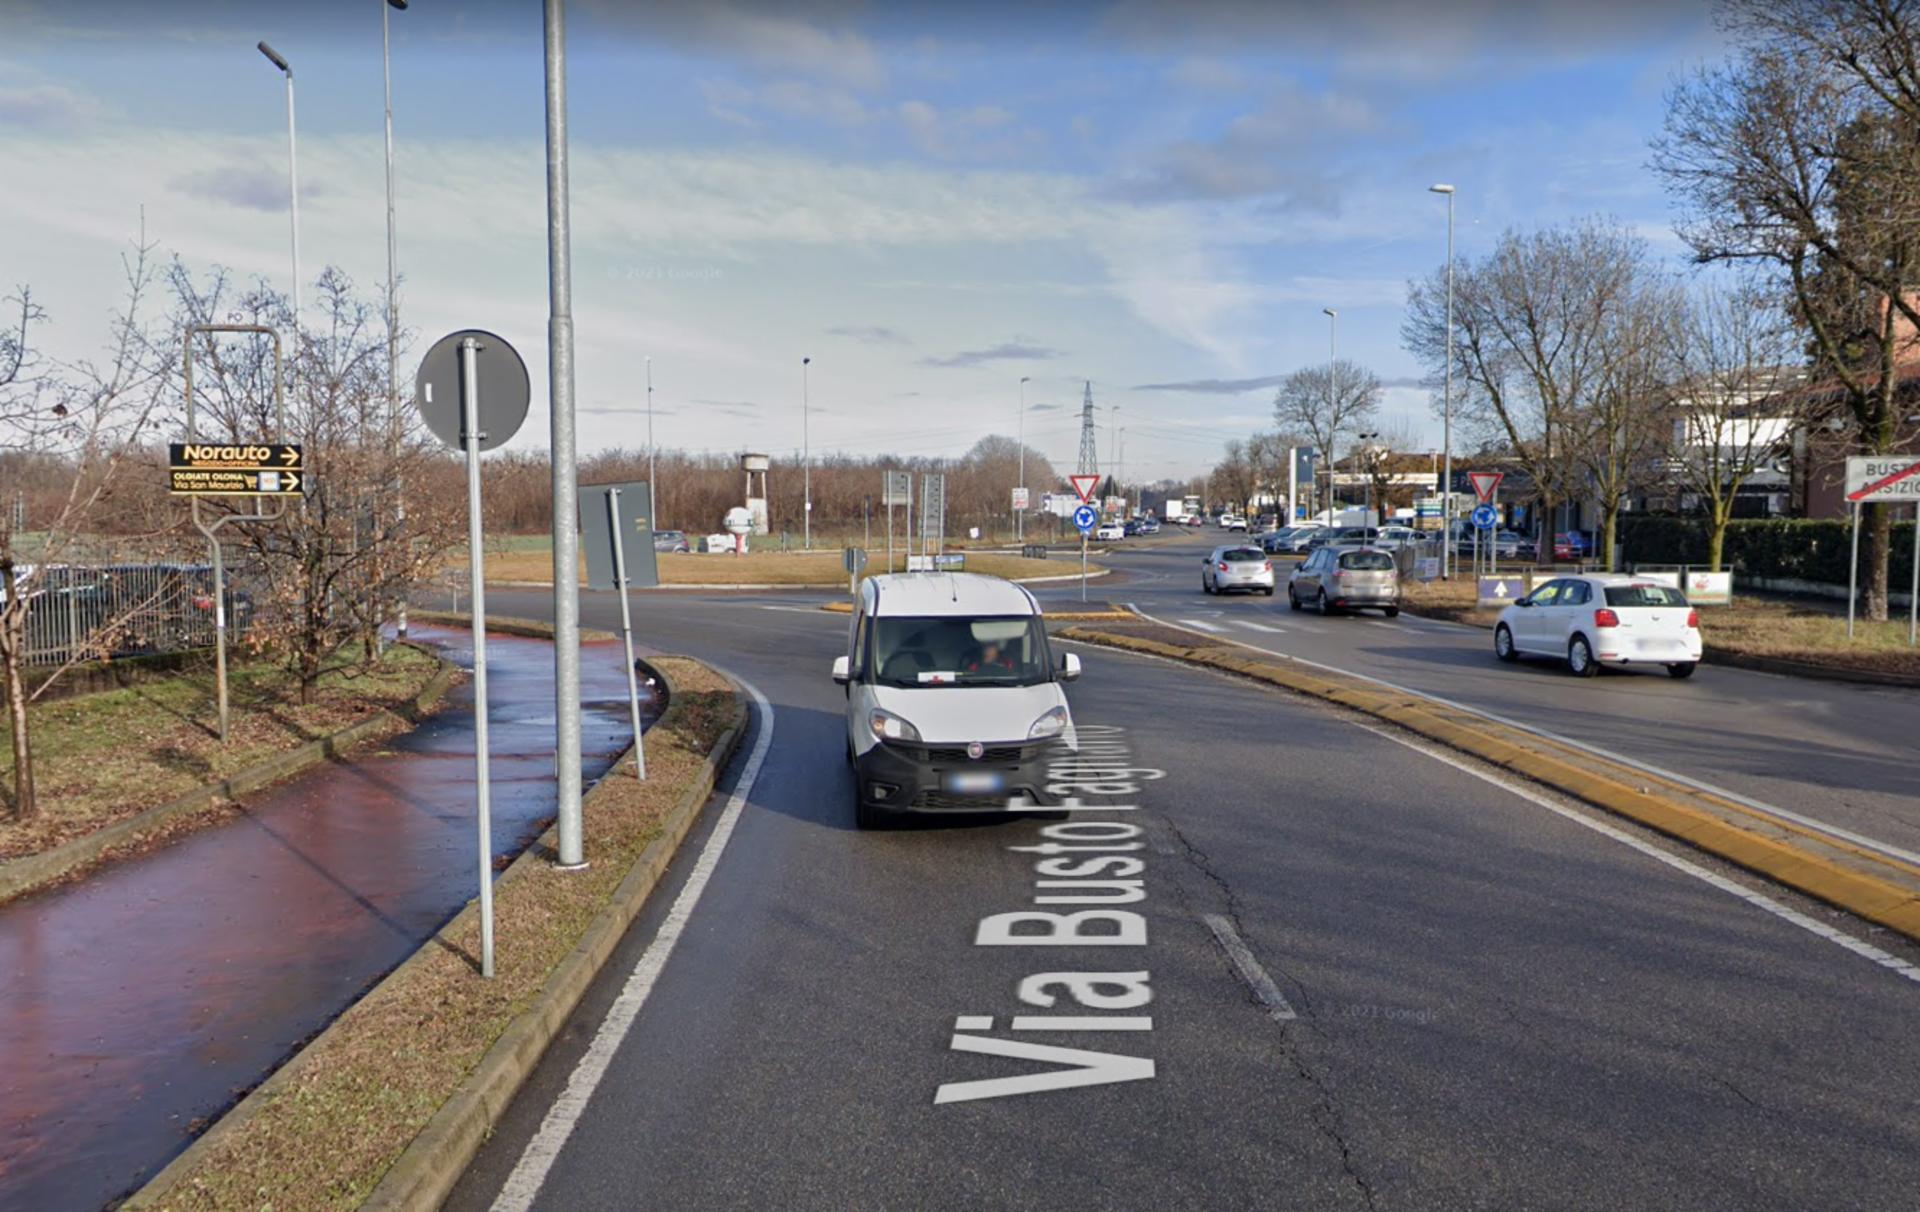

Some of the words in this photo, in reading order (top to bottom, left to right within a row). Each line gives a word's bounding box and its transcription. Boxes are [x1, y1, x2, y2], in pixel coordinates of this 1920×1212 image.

[183, 445, 271, 460] Norauto
[173, 472, 210, 480] OLGIATE
[211, 472, 244, 480] OLONA
[173, 481, 188, 489] Via
[190, 481, 206, 489] San
[208, 481, 245, 490] Maurizio
